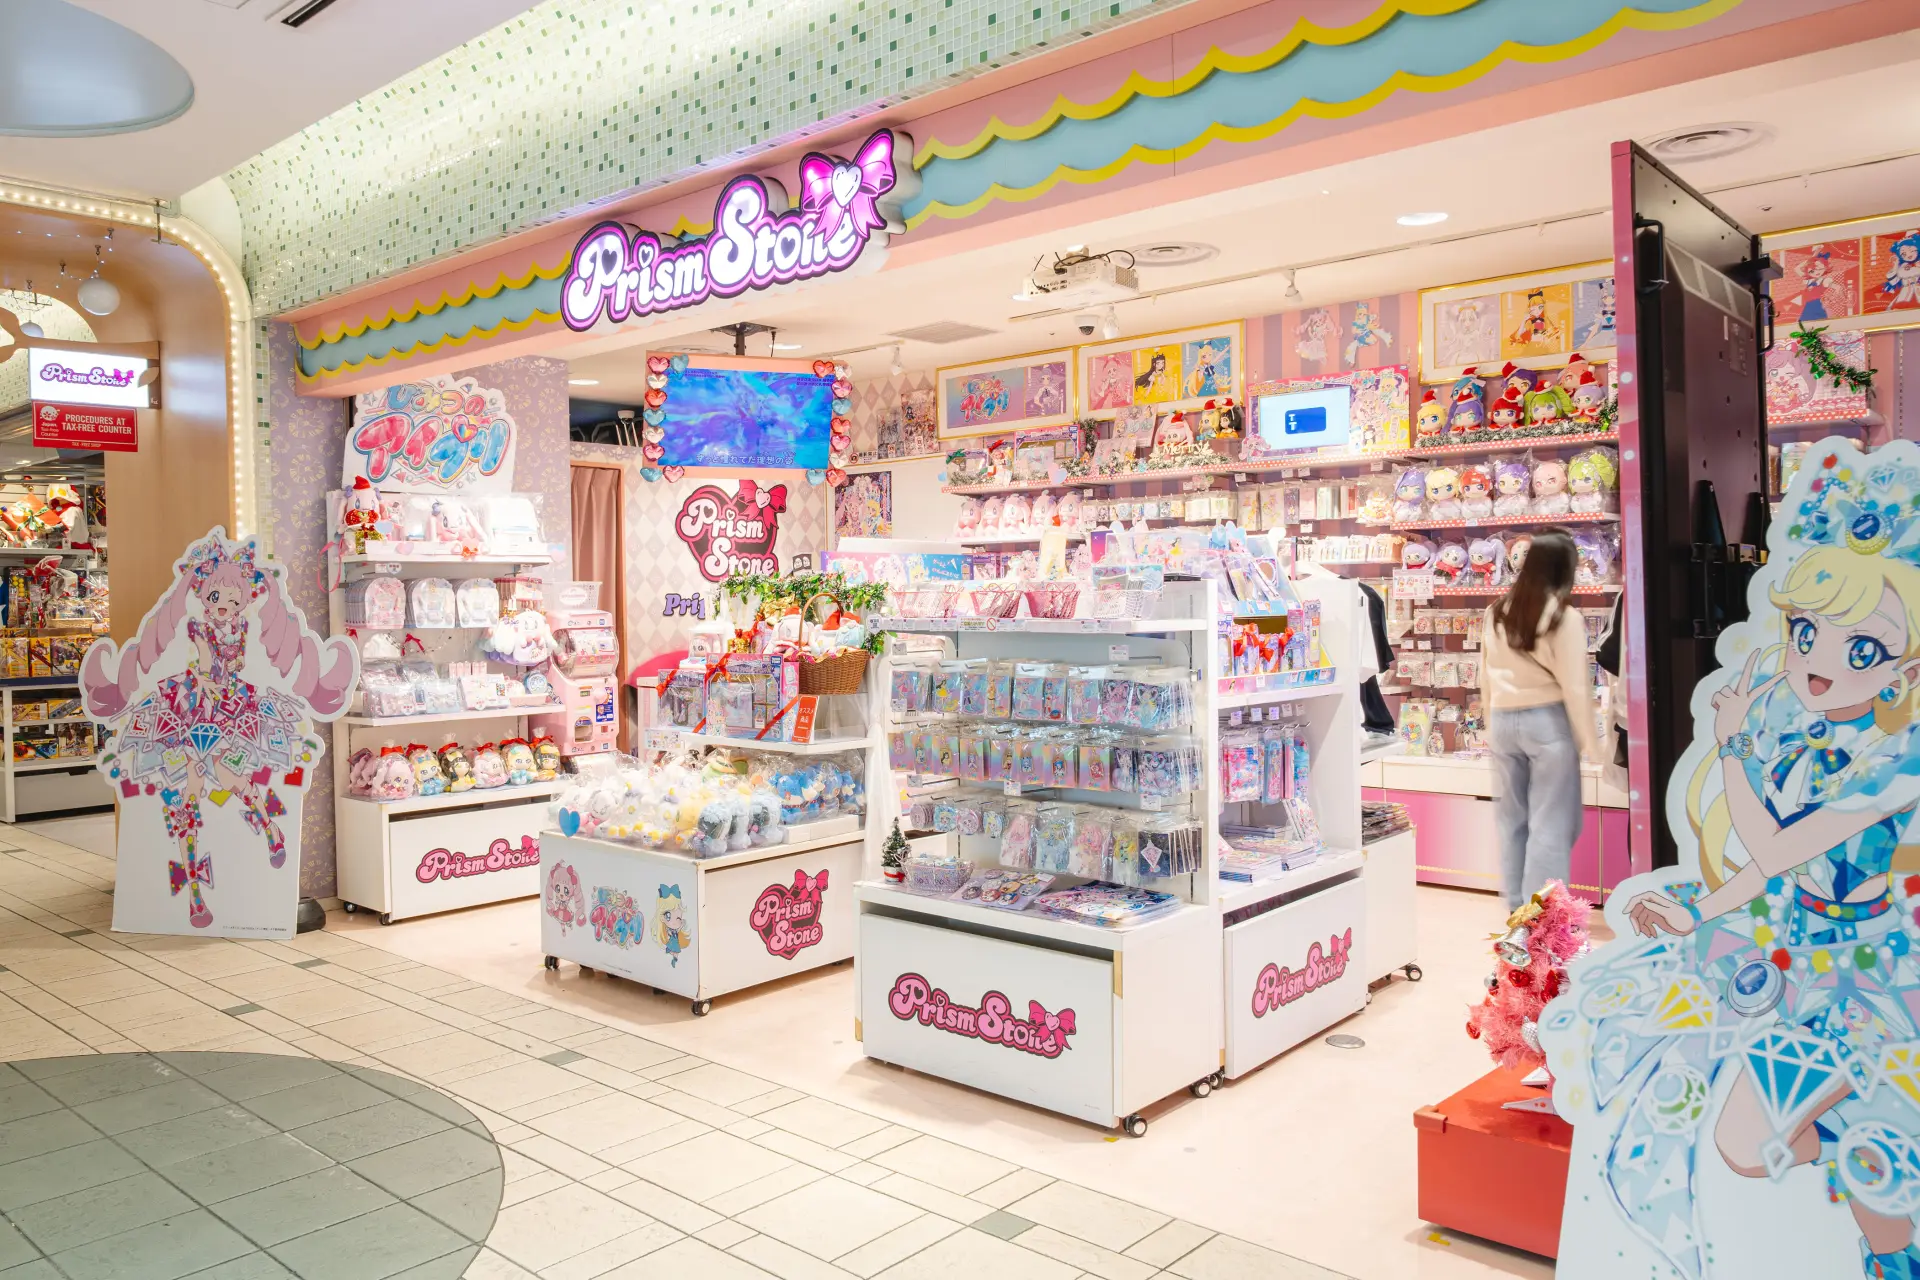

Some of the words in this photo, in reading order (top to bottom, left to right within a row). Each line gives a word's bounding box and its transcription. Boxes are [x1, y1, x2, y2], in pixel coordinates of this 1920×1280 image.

[564, 229, 707, 324] Prism
[708, 183, 862, 287] Stone
[41, 363, 88, 383] Prism
[88, 367, 129, 387] Stone
[65, 413, 114, 425] PROCEDURES
[116, 417, 126, 425] AT
[387, 384, 486, 416] ひみつの
[61, 422, 96, 432] TAX-FREE
[98, 425, 132, 435] COUNTER
[353, 412, 511, 484] アイプリ
[680, 498, 764, 539] Prism
[704, 537, 775, 577] Stone
[418, 851, 486, 881] Prism
[486, 841, 540, 869] Stone
[753, 894, 812, 927] Prism
[769, 919, 820, 951] Stone
[1253, 966, 1304, 1013] Prism
[1304, 946, 1345, 989] Stone
[892, 977, 977, 1033] Prism
[977, 996, 1059, 1054] Stone
